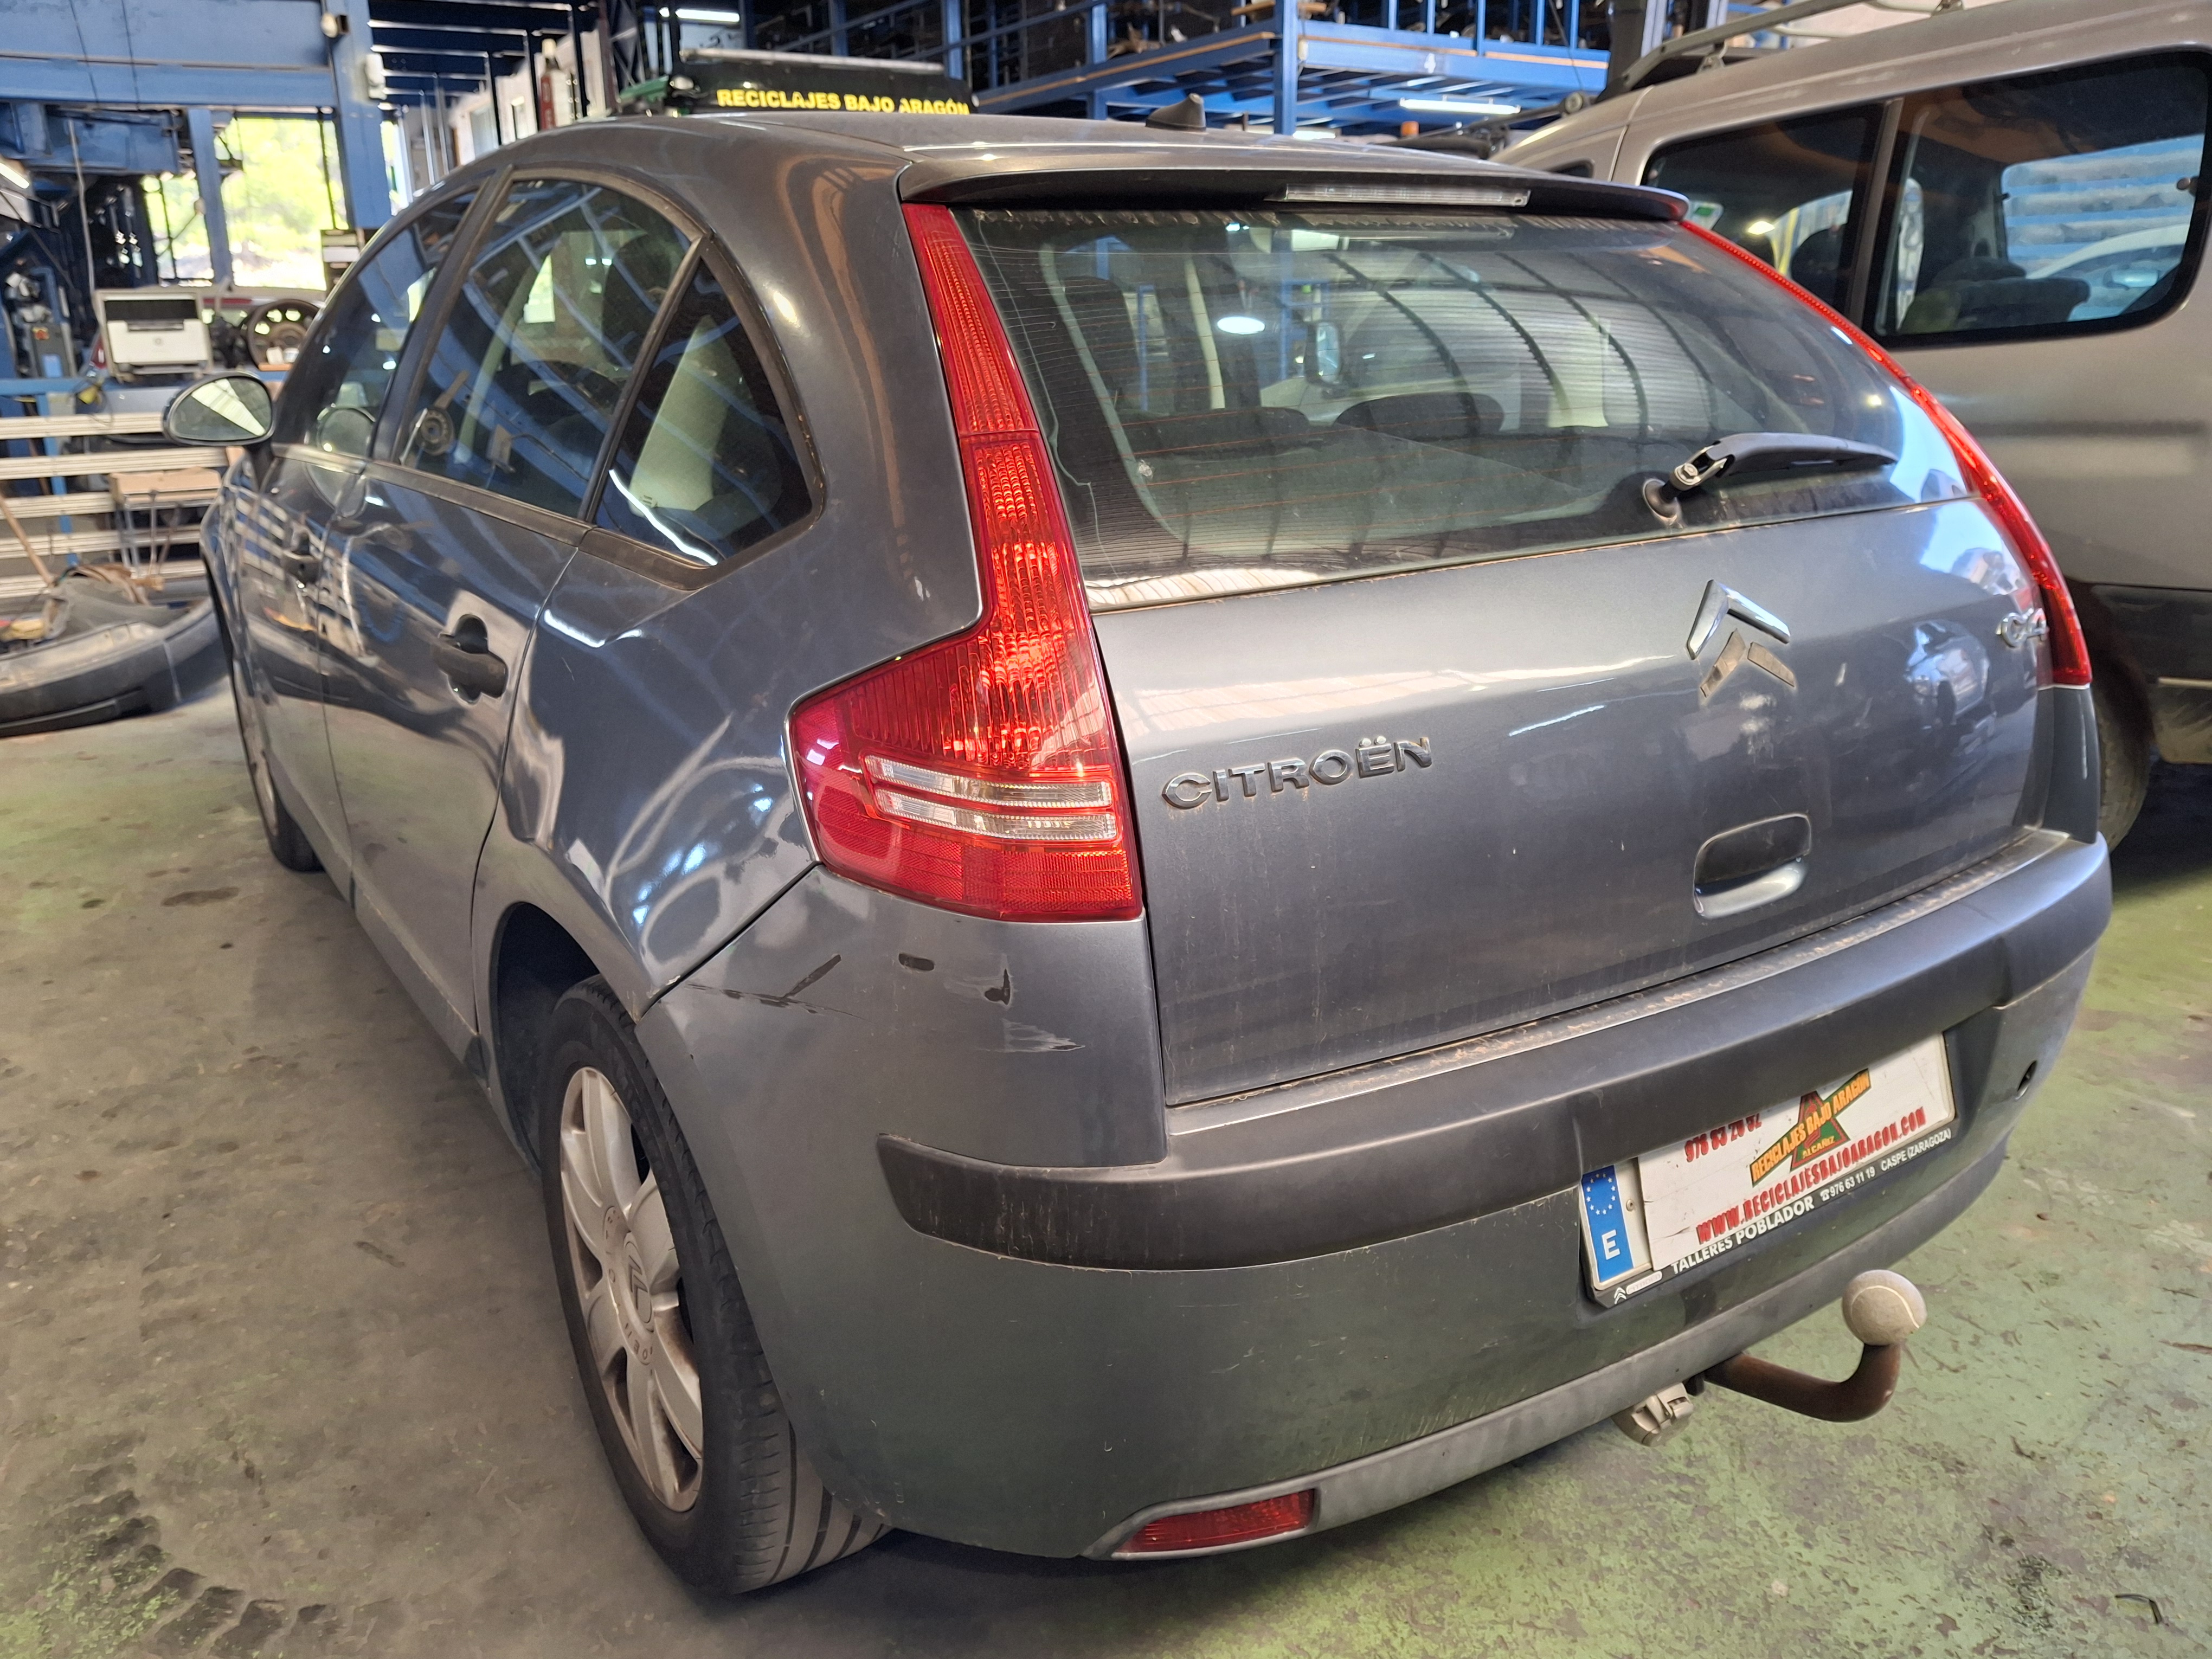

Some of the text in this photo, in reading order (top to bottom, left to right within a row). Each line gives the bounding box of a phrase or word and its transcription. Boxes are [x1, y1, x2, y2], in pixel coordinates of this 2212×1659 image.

[717, 89, 970, 115] RECICLAJES BAJO ARAGÓN
[1161, 735, 1432, 809] CITROËN
[1696, 1106, 1927, 1245] WWW.RECICLAJESBAJOARAGON.COM
[1751, 1123, 1806, 1183] RECICLAJES
[1805, 1102, 1832, 1135] BAJO
[1670, 1127, 1952, 1275] TALLERES POBLADOR 976 63 11 19 CASPE (ZARAGOZA)
[1602, 1229, 1621, 1261] E
